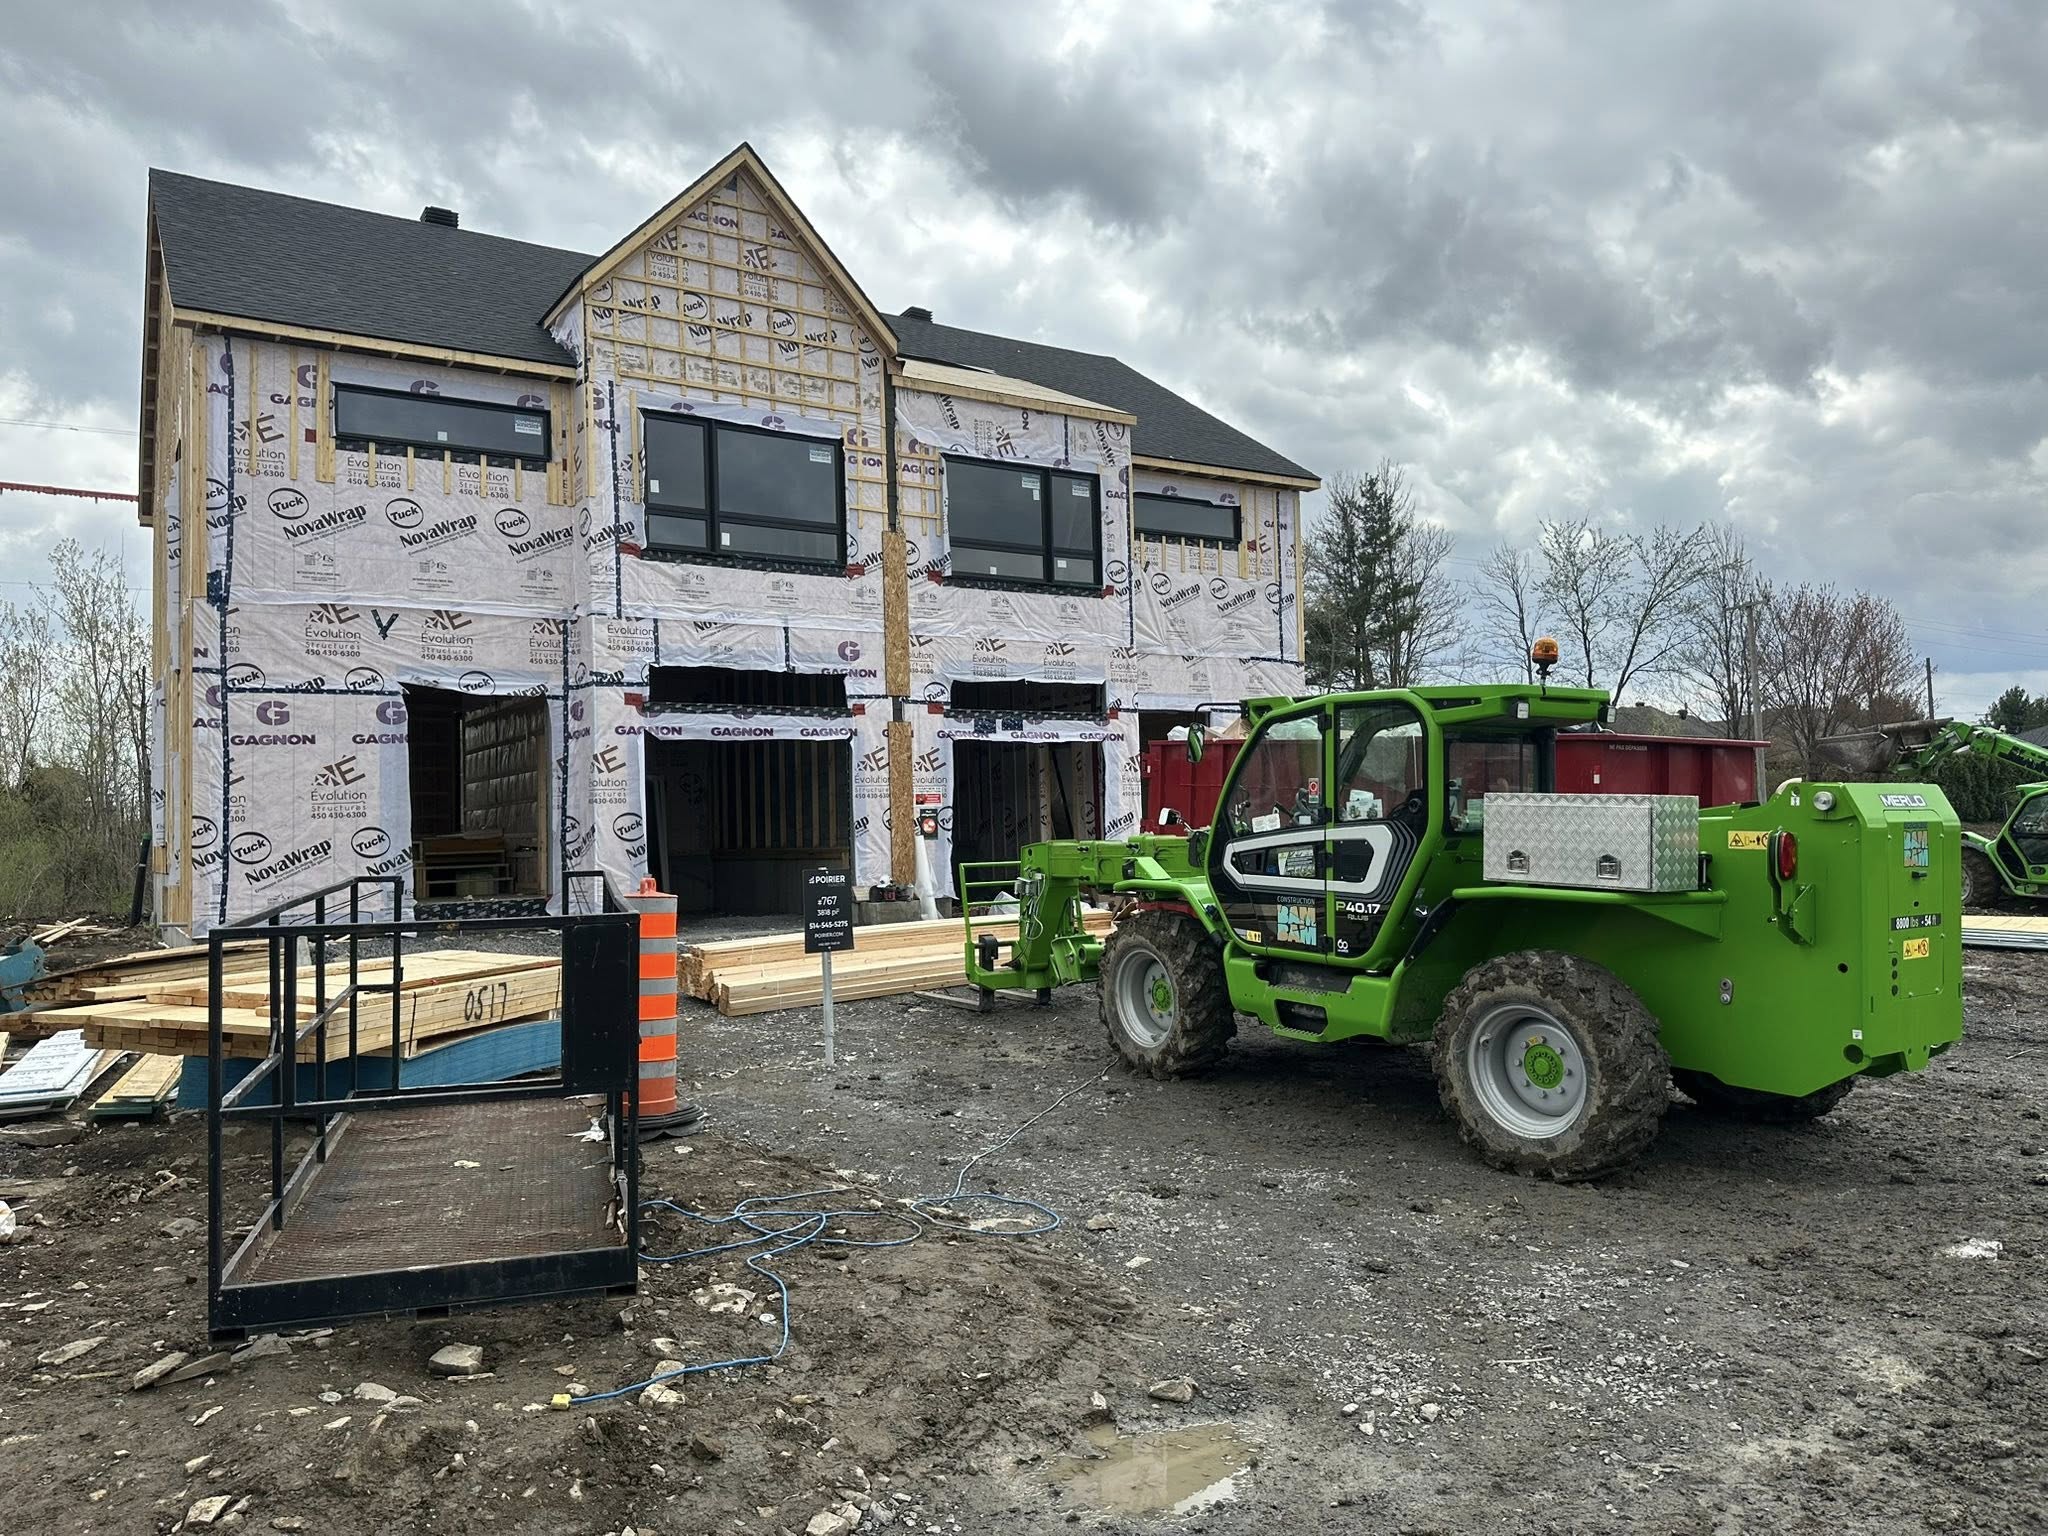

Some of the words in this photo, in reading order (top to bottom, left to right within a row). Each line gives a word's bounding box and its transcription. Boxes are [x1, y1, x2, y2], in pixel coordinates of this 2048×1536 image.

[206, 487, 225, 500] uck
[273, 497, 304, 512] Tuck
[390, 505, 419, 522] Tuck
[283, 505, 367, 540] NovaWrap
[499, 516, 526, 530] Tuck
[400, 514, 478, 548] NovaWrap
[1110, 567, 1126, 577] Tuck
[1153, 579, 1169, 589] Tuck
[1211, 583, 1227, 594] Tuck
[1159, 583, 1201, 608] NovaWrap
[1216, 587, 1257, 612] NovaWrap
[305, 625, 361, 639] Évolution
[421, 631, 473, 645] Évolution
[305, 642, 360, 650] Structures
[421, 647, 473, 655] Structures
[322, 649, 360, 657] 430-6300
[437, 654, 473, 662] 430-6300
[973, 654, 1008, 664] Évolution
[1043, 657, 1076, 667] Évolution
[229, 670, 261, 687] Tuck
[350, 675, 380, 690] Tuck
[463, 679, 491, 692] Tuck
[926, 688, 946, 701] Tuck
[256, 701, 290, 726] G
[711, 727, 774, 737] GAGNON
[800, 727, 858, 737] GAGNON
[1010, 731, 1060, 740] GAGNON
[1079, 732, 1125, 742] GAGNON
[230, 735, 316, 745] GAGNON
[310, 789, 367, 801] Évolution
[1879, 794, 1927, 807] MERLO
[328, 811, 367, 819] 430-6300
[192, 823, 213, 838] uck
[617, 819, 642, 836] Tuck
[234, 840, 266, 858] Tuck
[356, 834, 386, 852] Tuck
[244, 839, 332, 885] NovaWrap
[815, 875, 846, 884] POIRIER
[1276, 895, 1316, 905] CONSTRUCTION
[1336, 901, 1381, 914] P40.17
[1896, 917, 1909, 929] 8800
[1910, 916, 1919, 927] lbs
